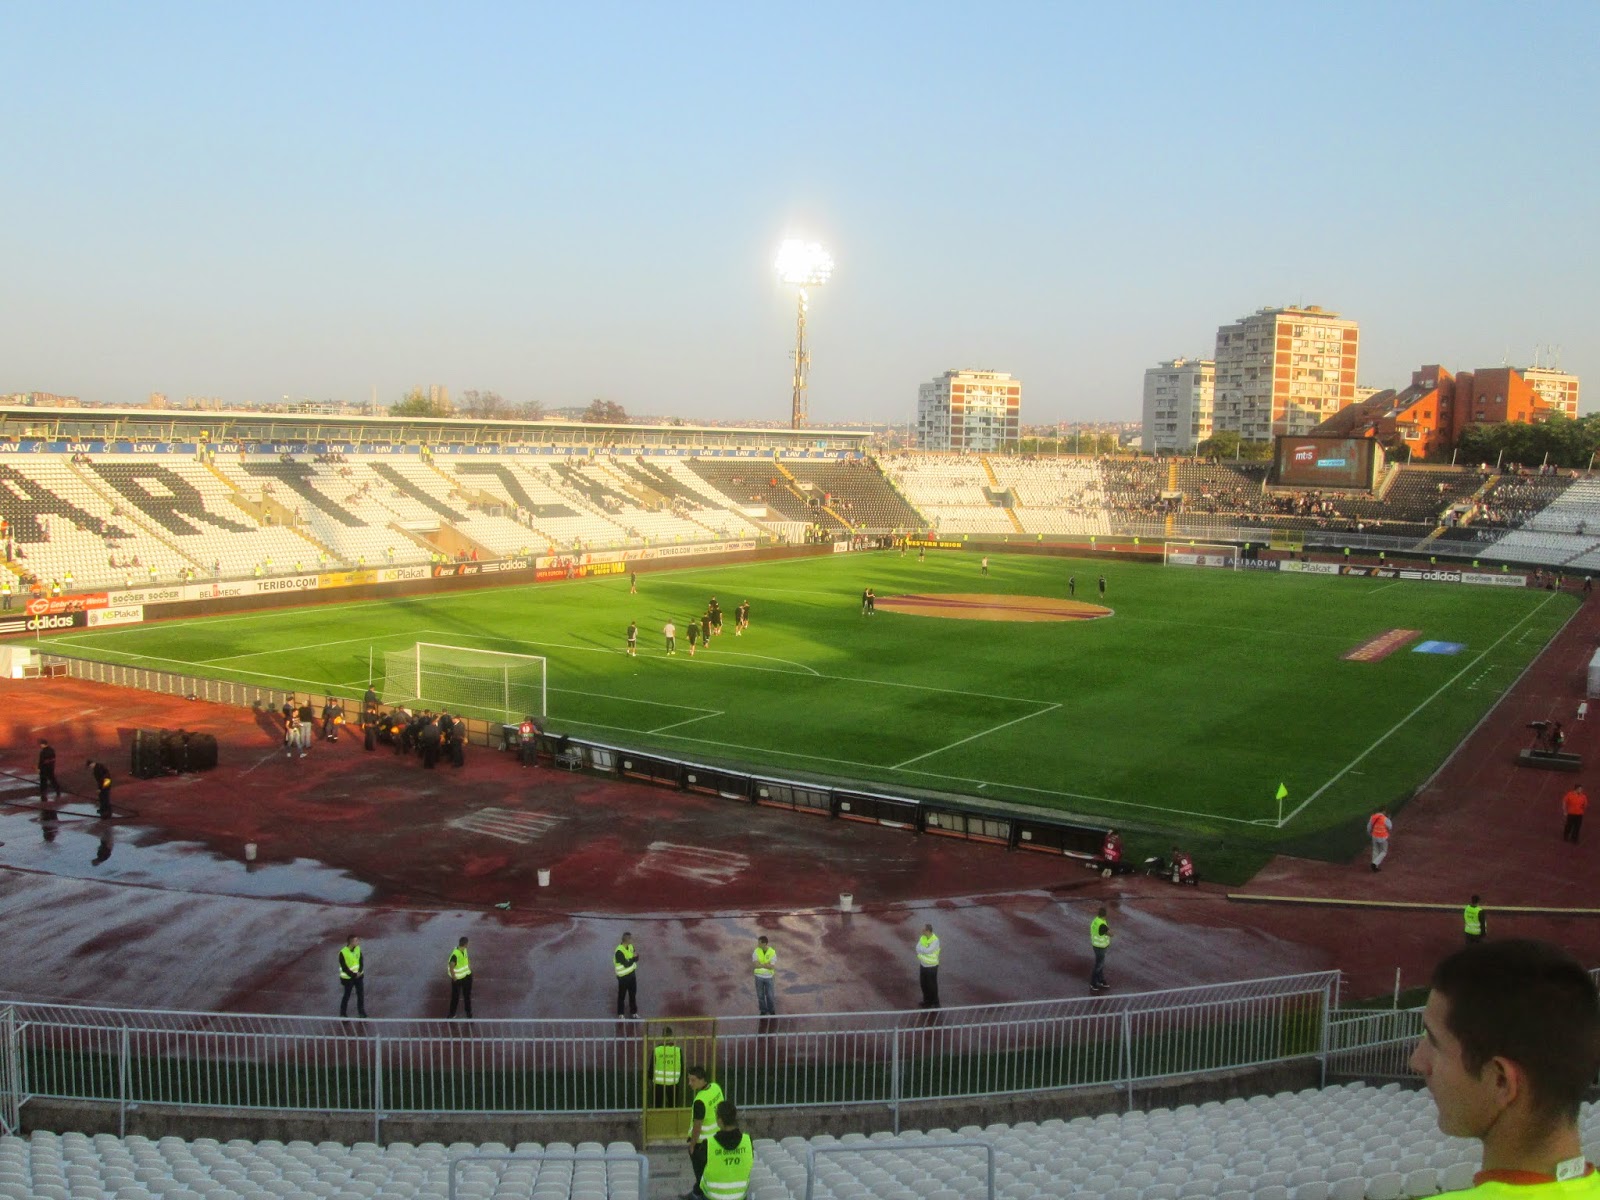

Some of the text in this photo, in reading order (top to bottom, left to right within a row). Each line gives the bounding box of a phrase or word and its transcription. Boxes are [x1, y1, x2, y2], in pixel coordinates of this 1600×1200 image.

[0, 443, 20, 452] AV
[67, 443, 91, 452] LAV
[133, 444, 156, 452] LAV
[217, 444, 238, 453] LAV
[327, 445, 345, 453] LAV
[434, 446, 450, 454] LAV
[500, 560, 527, 571] adidas
[1423, 571, 1460, 581] adidas
[257, 578, 317, 591] TERIBO.COM
[27, 615, 74, 630] adidas
[725, 1157, 741, 1166] 170
